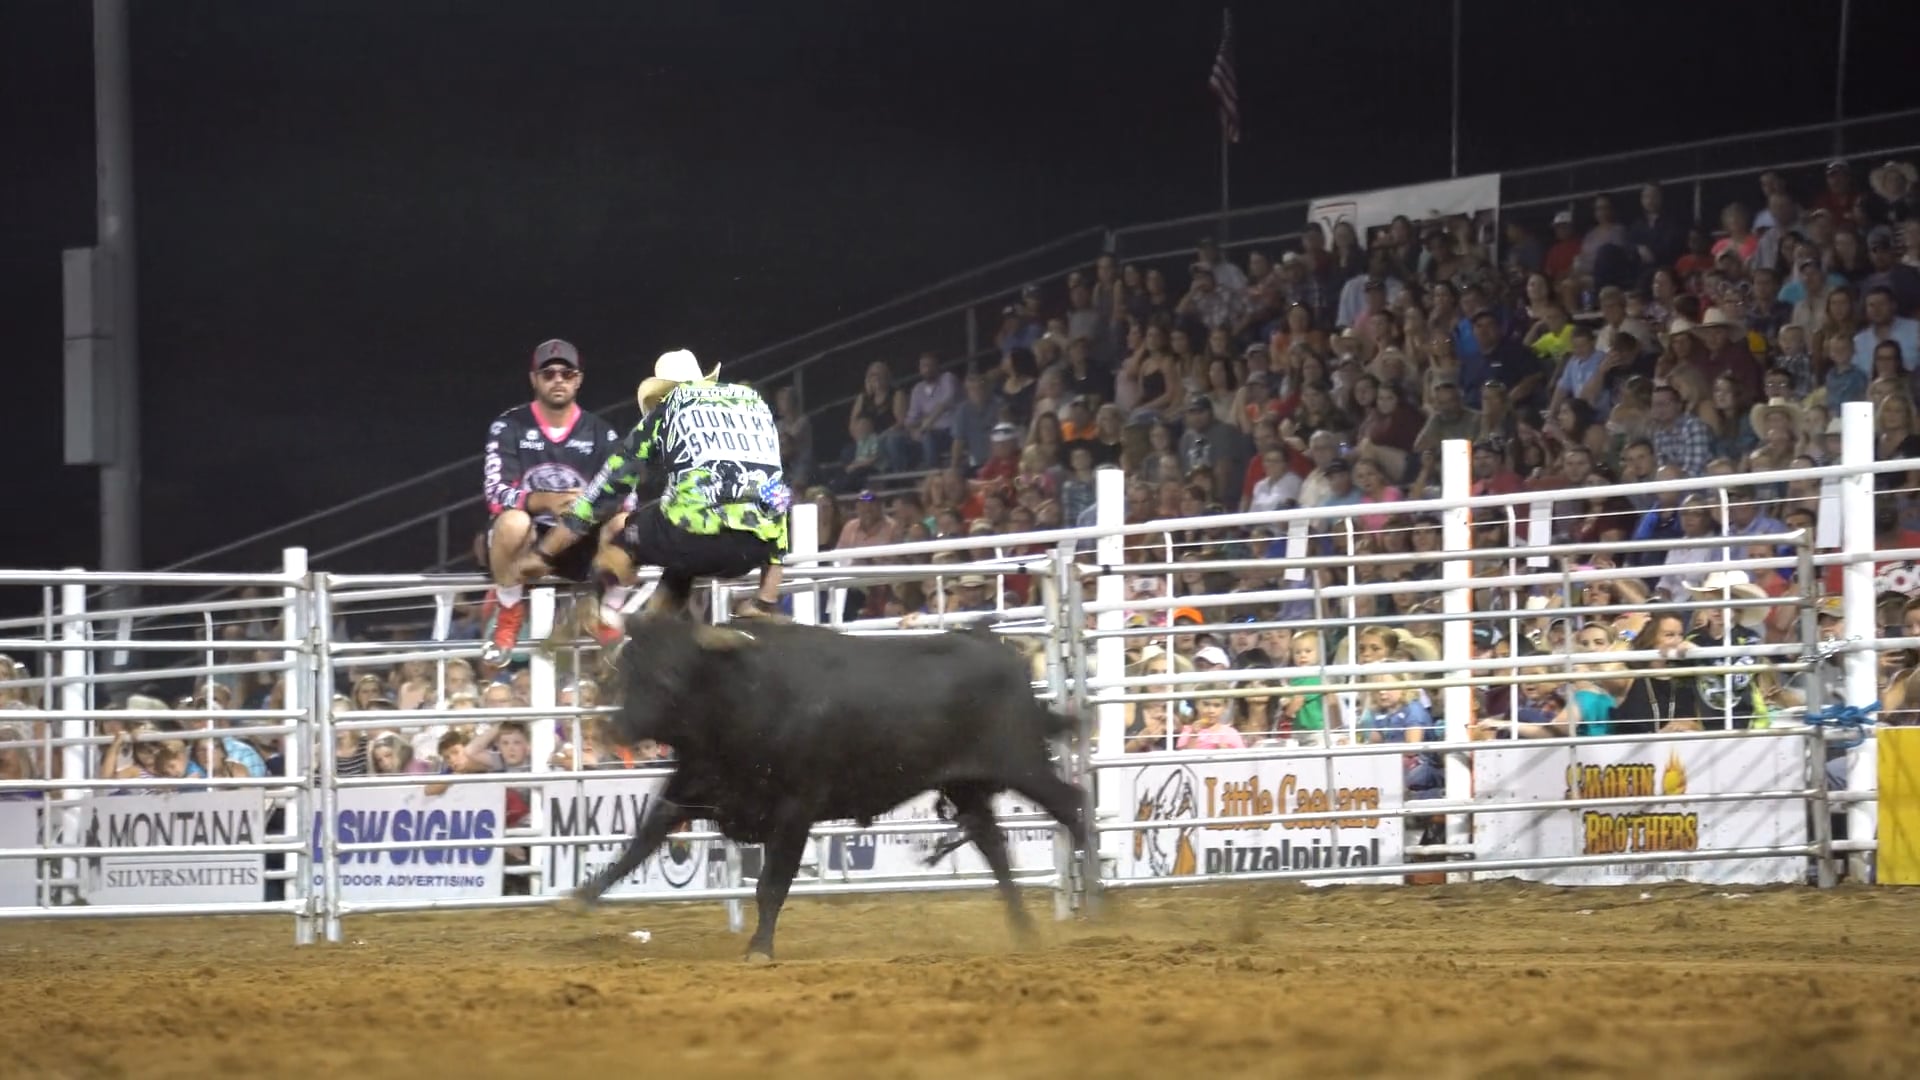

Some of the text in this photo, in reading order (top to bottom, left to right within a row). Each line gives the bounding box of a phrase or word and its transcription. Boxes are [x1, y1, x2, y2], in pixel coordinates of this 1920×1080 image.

[689, 431, 776, 456] SMOOTH
[1204, 775, 1273, 830] Little
[109, 810, 256, 849] MONTANA
[391, 809, 496, 865] SIGNS
[1583, 810, 1698, 854] BROTHERS
[106, 866, 258, 889] SILVERSMITHS
[313, 874, 485, 889] ODOOR ADVERTISING
